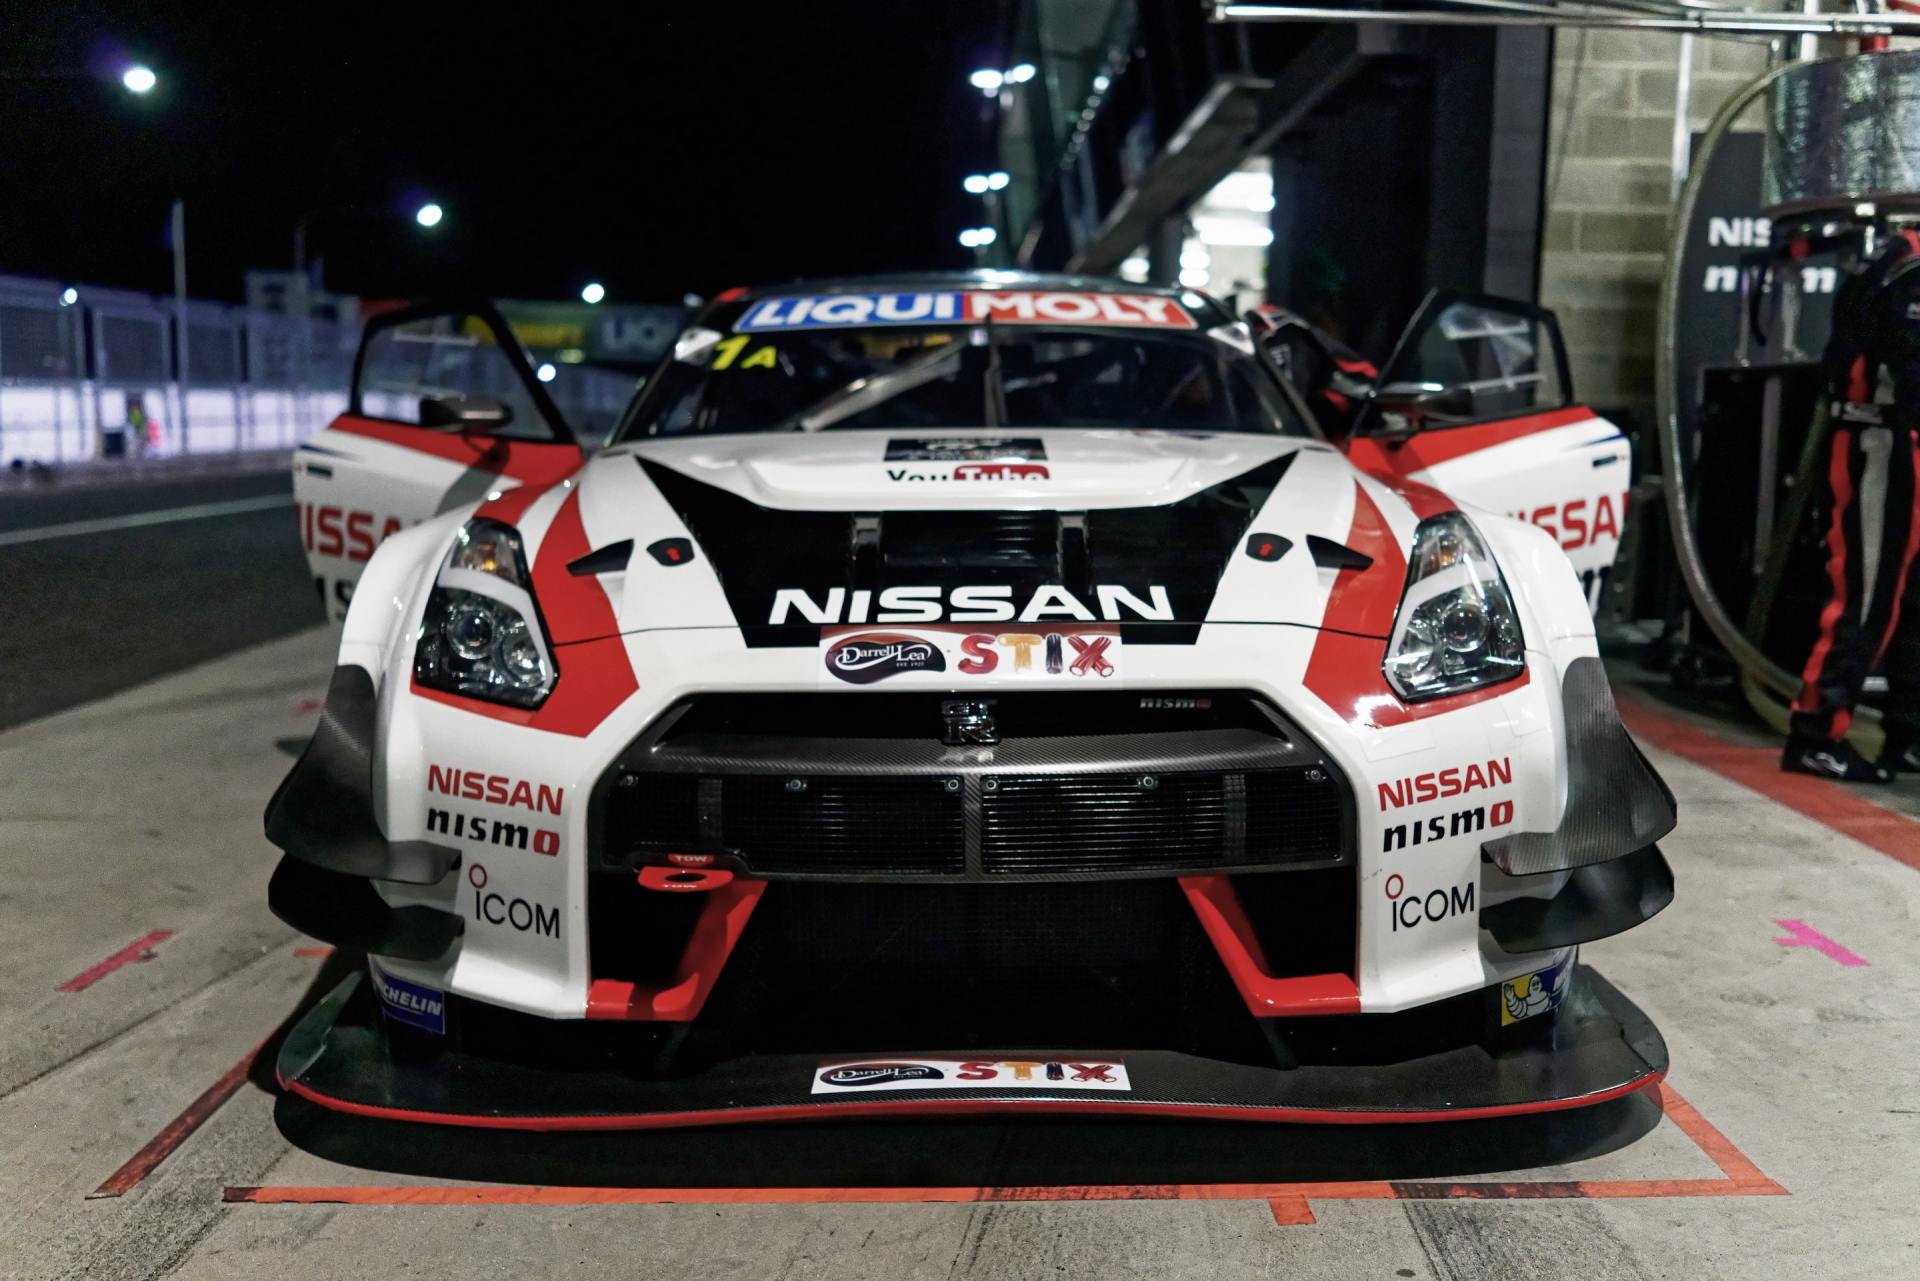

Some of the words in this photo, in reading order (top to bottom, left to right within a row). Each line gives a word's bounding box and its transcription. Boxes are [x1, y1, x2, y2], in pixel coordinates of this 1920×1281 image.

[1708, 216, 1772, 248] NIS
[751, 294, 956, 326] LIQUI
[972, 292, 1169, 323] MOLY
[768, 585, 1175, 625] NISSAN
[835, 645, 895, 668] Darrell
[896, 645, 927, 661] Lea
[957, 633, 1115, 678] STIX
[427, 764, 564, 816] NISSAN
[1377, 757, 1512, 812] NISSAN
[426, 808, 560, 857] nismo
[1383, 800, 1513, 852] nismo
[383, 983, 442, 1017] CHELIN
[956, 1062, 1117, 1082] STIX
